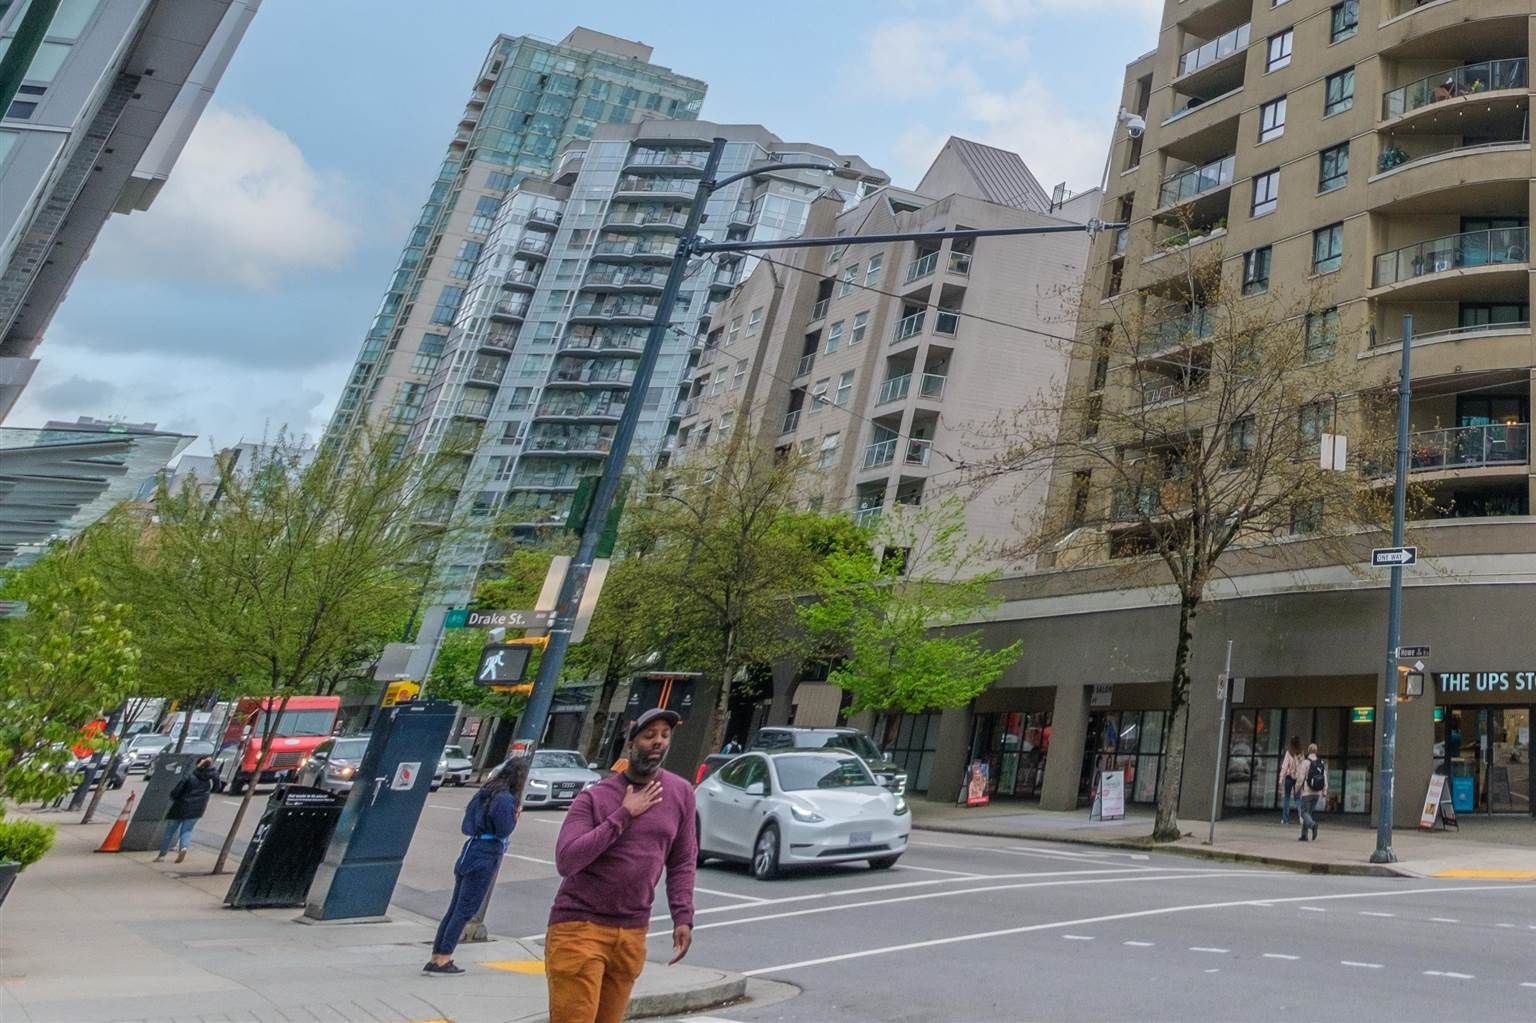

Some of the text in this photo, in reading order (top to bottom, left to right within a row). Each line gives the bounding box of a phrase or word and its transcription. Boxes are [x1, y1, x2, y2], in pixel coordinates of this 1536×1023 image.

[468, 613, 506, 625] Drake
[508, 612, 526, 625] St.
[1441, 673, 1470, 692] THE
[1476, 672, 1509, 691] UPS
